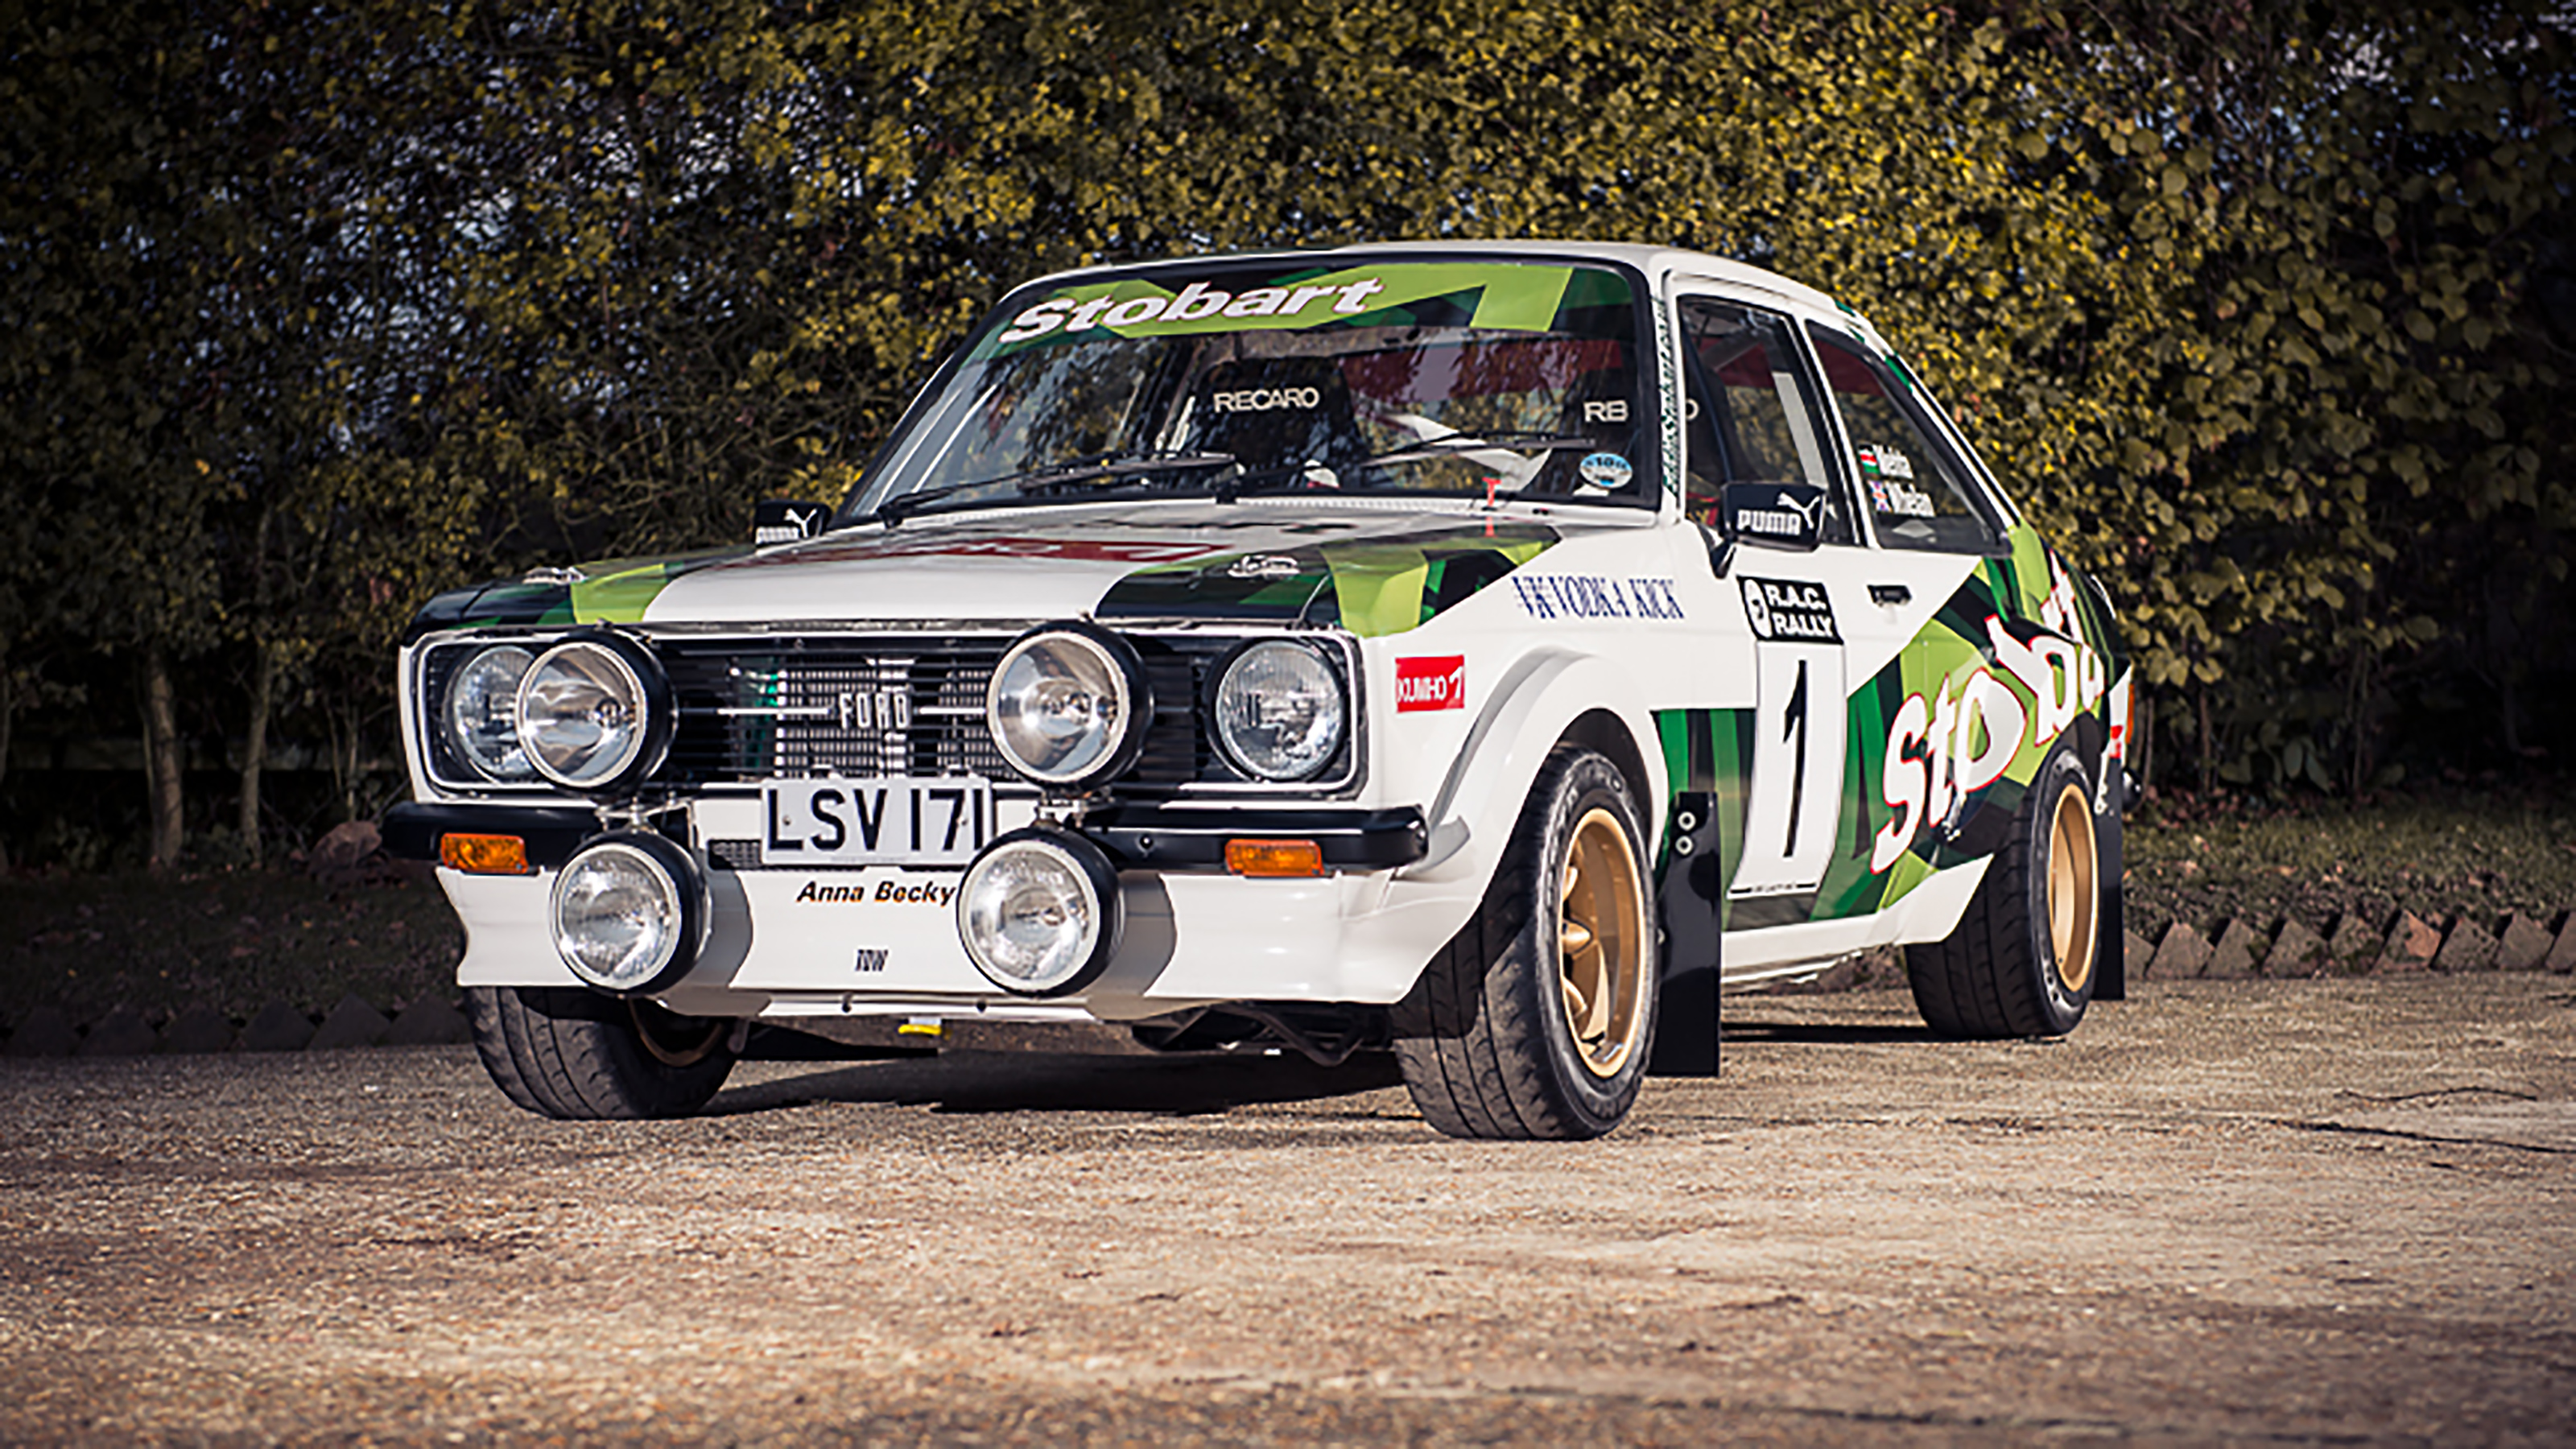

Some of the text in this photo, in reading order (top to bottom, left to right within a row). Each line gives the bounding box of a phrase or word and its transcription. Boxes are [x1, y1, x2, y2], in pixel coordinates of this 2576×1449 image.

[998, 277, 1384, 344] Stobart
[1213, 386, 1319, 413] RECARO
[1736, 509, 1802, 535] PUMA
[1547, 576, 1632, 619] VODKA
[1628, 578, 1685, 619] KICK
[1772, 612, 1835, 638] RALLY
[839, 692, 912, 730] FORD
[1783, 659, 1807, 858] 1
[767, 787, 985, 852] LSV 171
[795, 880, 956, 908] Anna Becky
